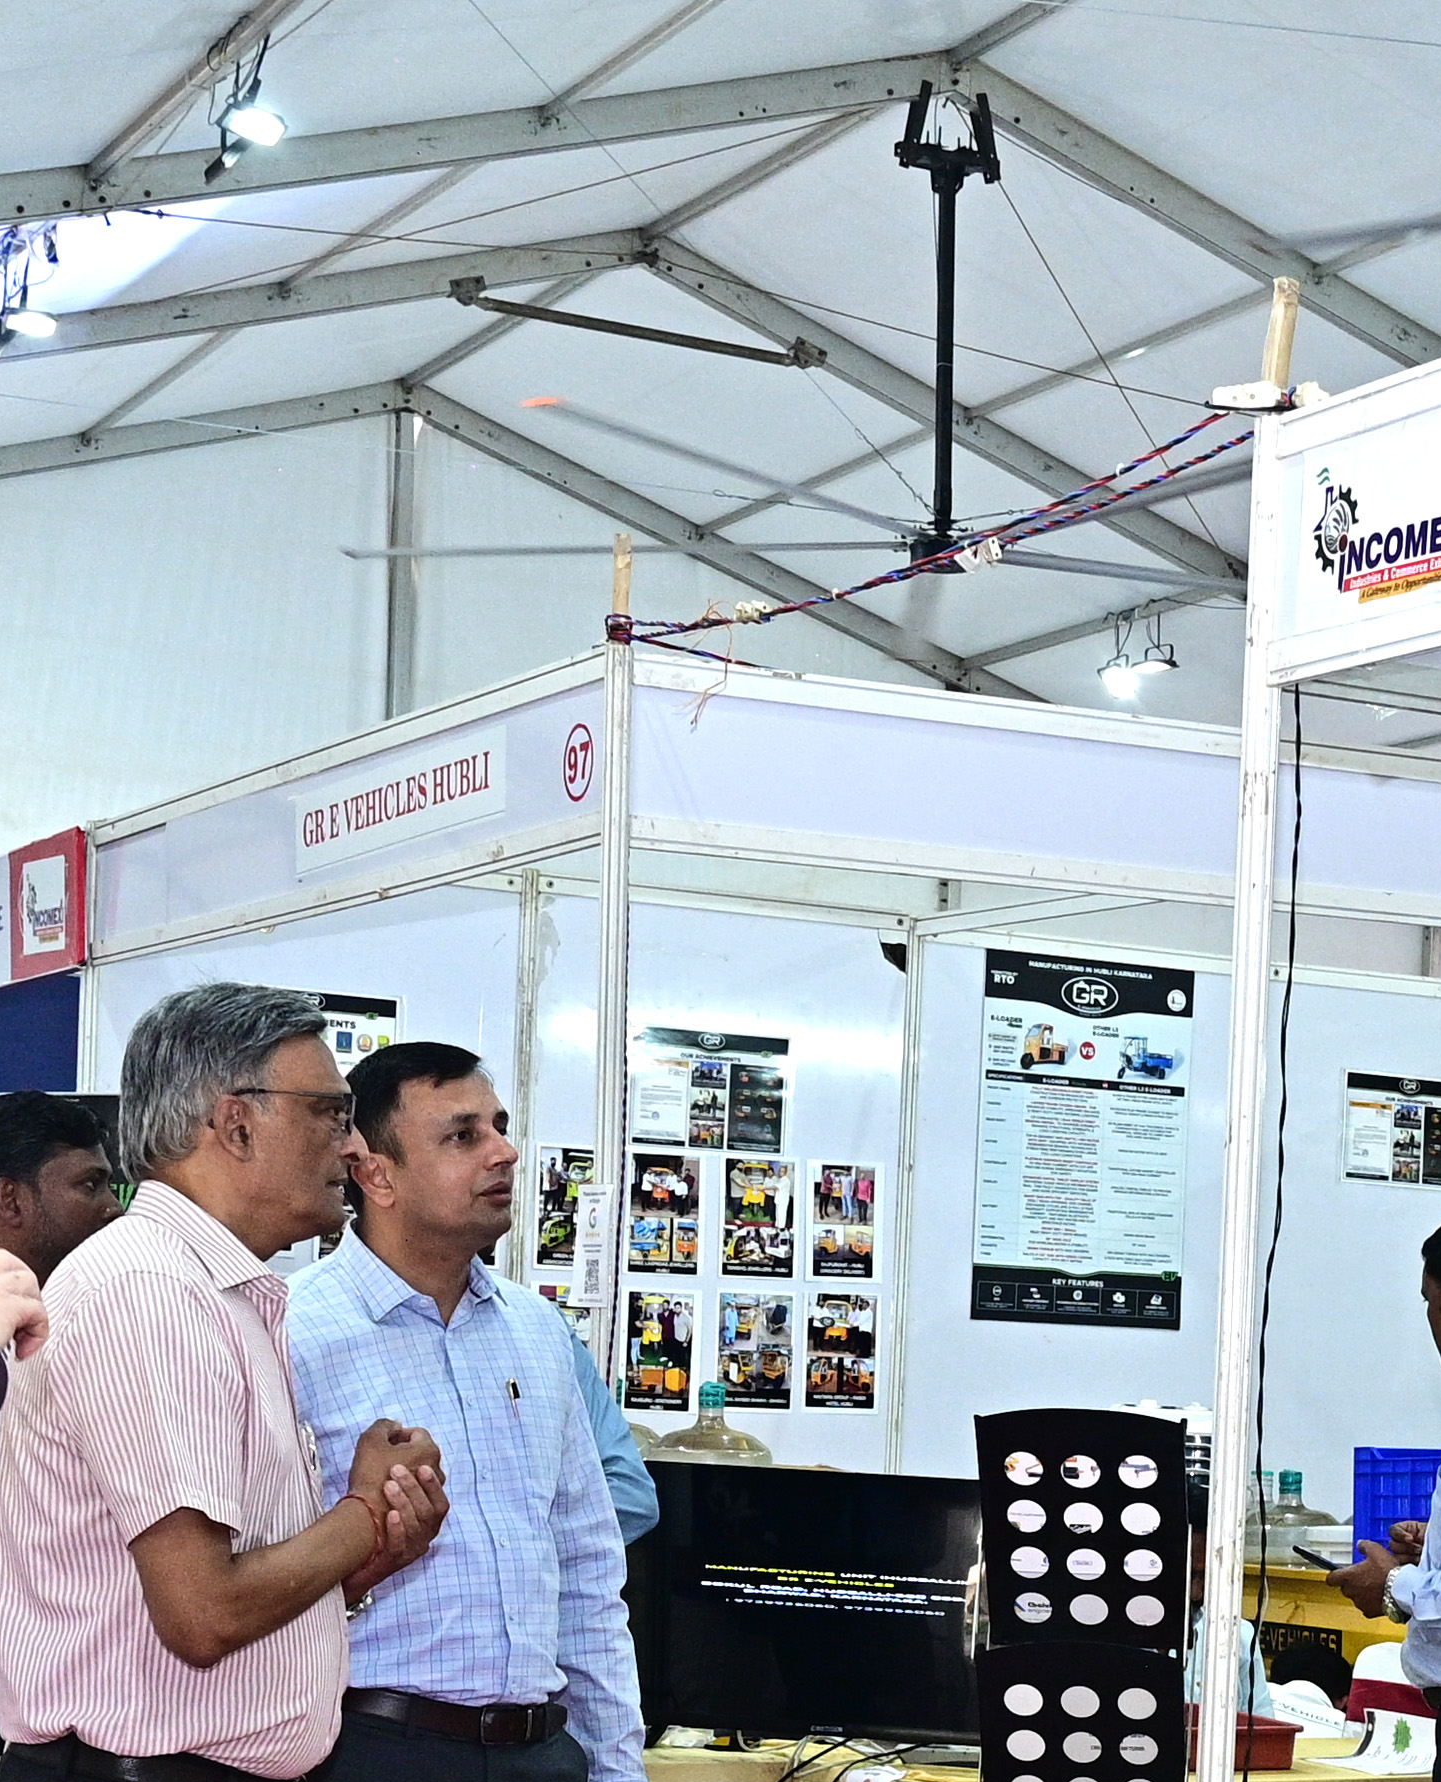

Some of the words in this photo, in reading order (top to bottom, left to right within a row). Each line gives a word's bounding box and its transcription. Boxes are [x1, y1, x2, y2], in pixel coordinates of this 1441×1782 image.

[1383, 571, 1389, 580] &
[1391, 562, 1427, 579] Commerce
[567, 740, 590, 784] 97
[303, 809, 325, 848] GR
[329, 803, 339, 839] E
[344, 771, 427, 835] VEHICLES
[432, 751, 491, 806] HUBLI
[1028, 959, 1084, 973] MANUFACTURING
[1086, 966, 1092, 974] IN
[1093, 967, 1113, 976] HUBLI
[1114, 969, 1153, 980] KARNATAKA
[993, 974, 1015, 985] RTO
[1073, 981, 1108, 1007] GR
[329, 1019, 356, 1029] ENTS
[1081, 1046, 1094, 1056] VS
[1052, 1278, 1066, 1286] KEY
[1068, 1279, 1103, 1288] FEATURES
[705, 1564, 835, 1577] MANUFACTURING
[840, 1572, 877, 1580] UNIT
